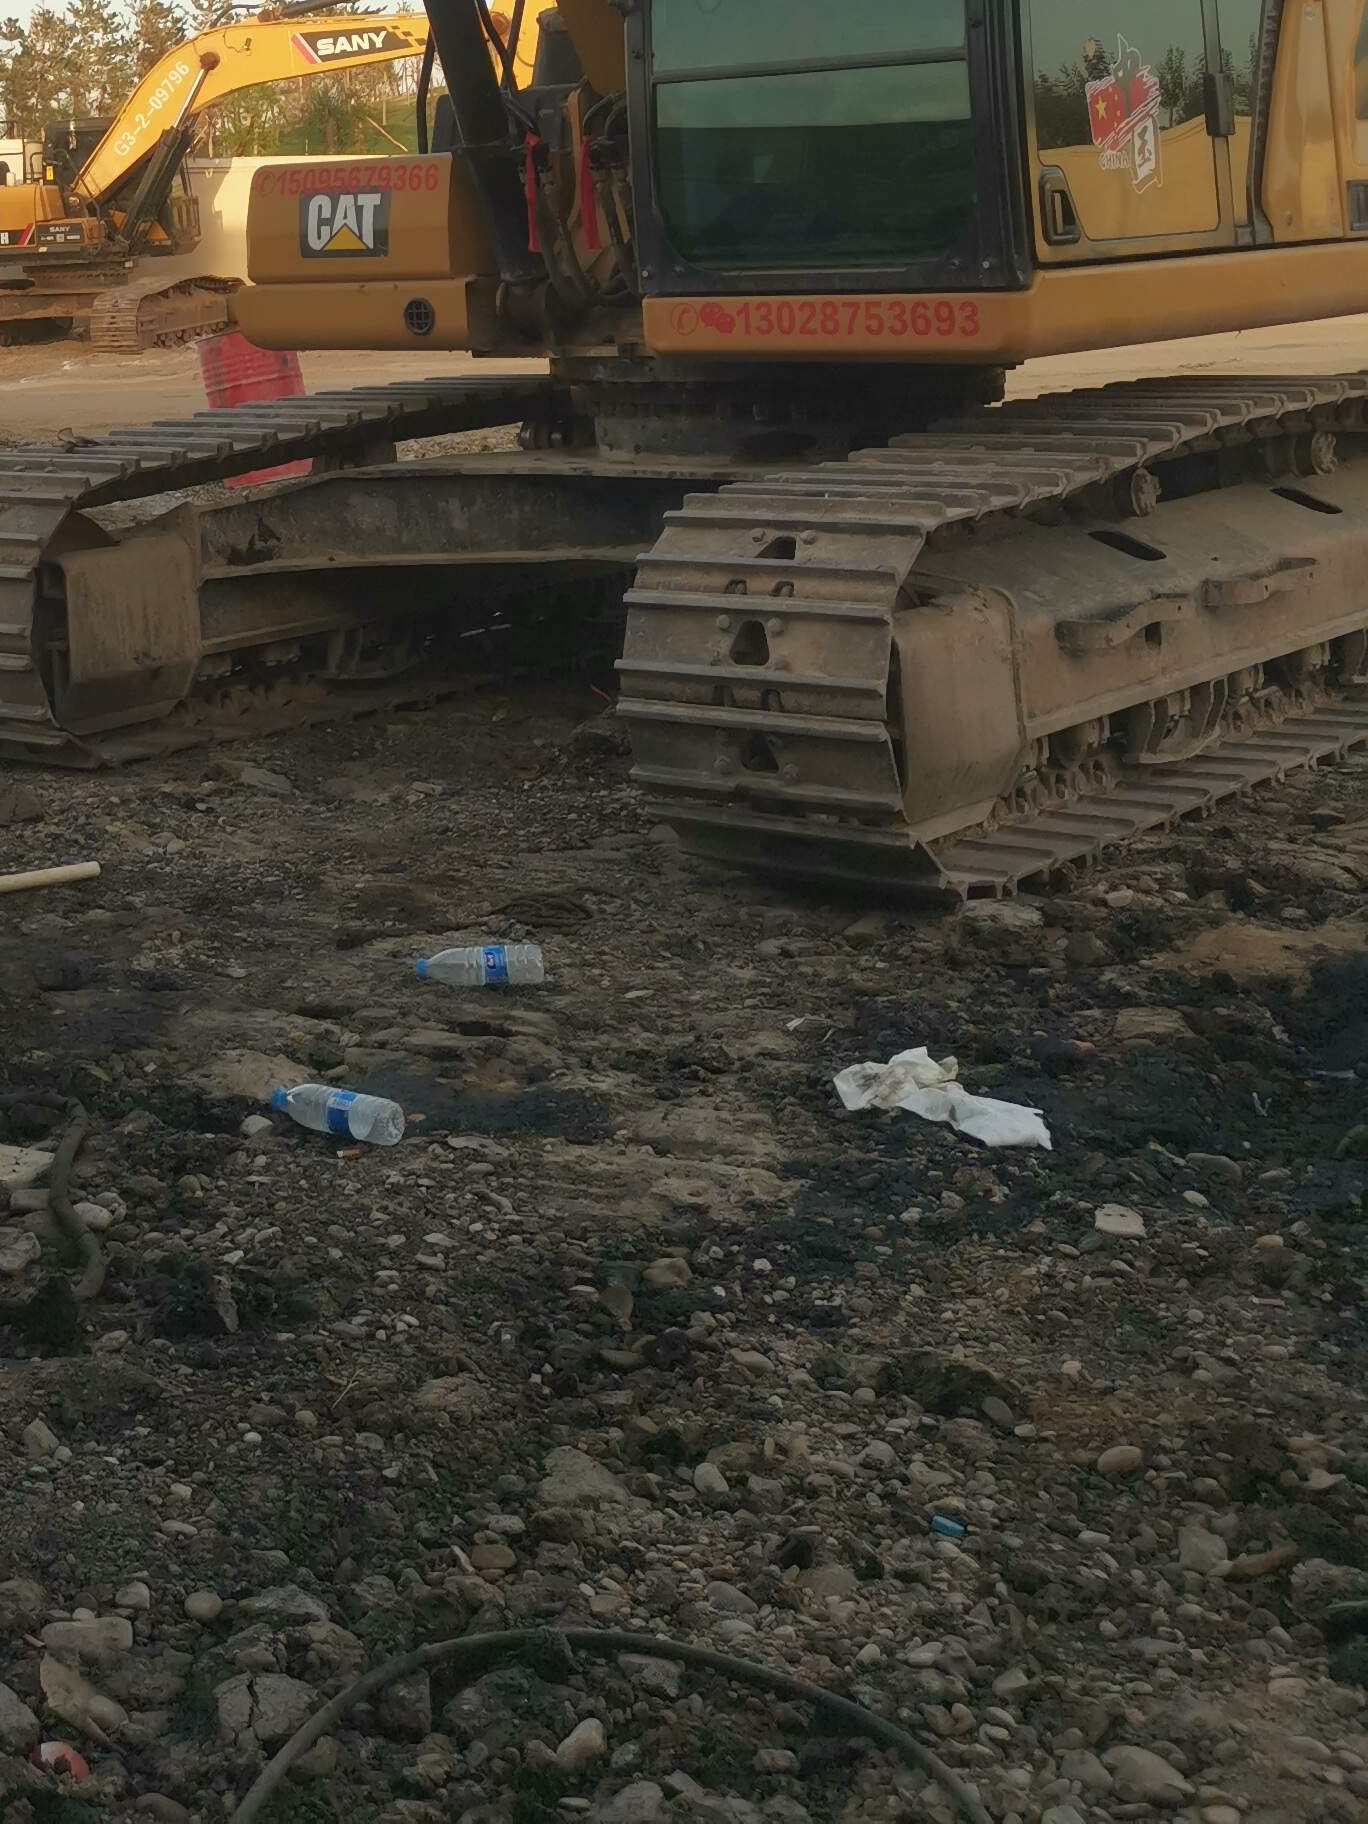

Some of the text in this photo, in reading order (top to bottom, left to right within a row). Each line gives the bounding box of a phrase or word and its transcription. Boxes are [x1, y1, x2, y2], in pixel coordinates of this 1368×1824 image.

[316, 30, 387, 56] SANY
[114, 61, 190, 156] G3-2-09796
[307, 192, 382, 251] CAT
[736, 300, 980, 338] 13028753693
